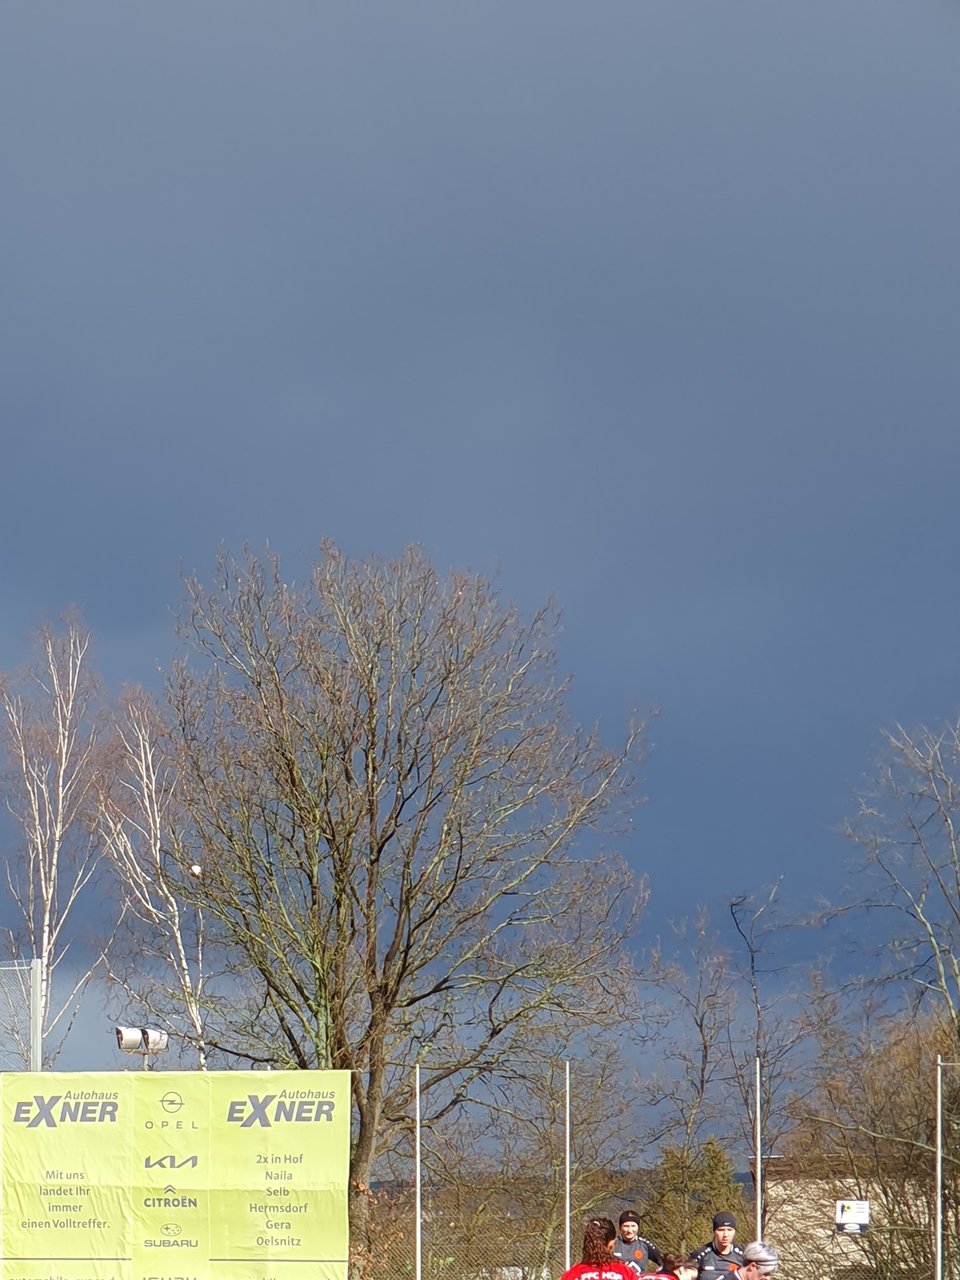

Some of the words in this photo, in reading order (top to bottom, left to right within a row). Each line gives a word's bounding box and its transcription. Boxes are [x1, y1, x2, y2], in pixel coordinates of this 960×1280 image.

[63, 1090, 119, 1100] Autohaus
[279, 1089, 336, 1099] Autohaus
[13, 1095, 119, 1128] EXNER
[227, 1094, 336, 1128] EXNER
[144, 1120, 199, 1130] OPEL
[144, 1155, 198, 1169] KIA
[256, 1154, 269, 1164] 2x
[271, 1154, 282, 1164] in
[284, 1154, 304, 1164] Hof
[45, 1170, 63, 1180] Mit
[66, 1171, 85, 1180] uns
[265, 1170, 293, 1180] Naila
[39, 1186, 74, 1196] landet
[75, 1186, 91, 1196] Ihr
[266, 1187, 290, 1197] Selb
[144, 1195, 198, 1208] CITROËN
[48, 1202, 83, 1212] immer
[249, 1203, 309, 1213] Hermsdorf
[21, 1219, 51, 1229] einen
[52, 1219, 111, 1229] Volltreffer.
[265, 1220, 292, 1230] Gera
[144, 1239, 199, 1248] SUBARU
[256, 1236, 302, 1247] Oelsnitz
[602, 1271, 623, 1280] HOF
